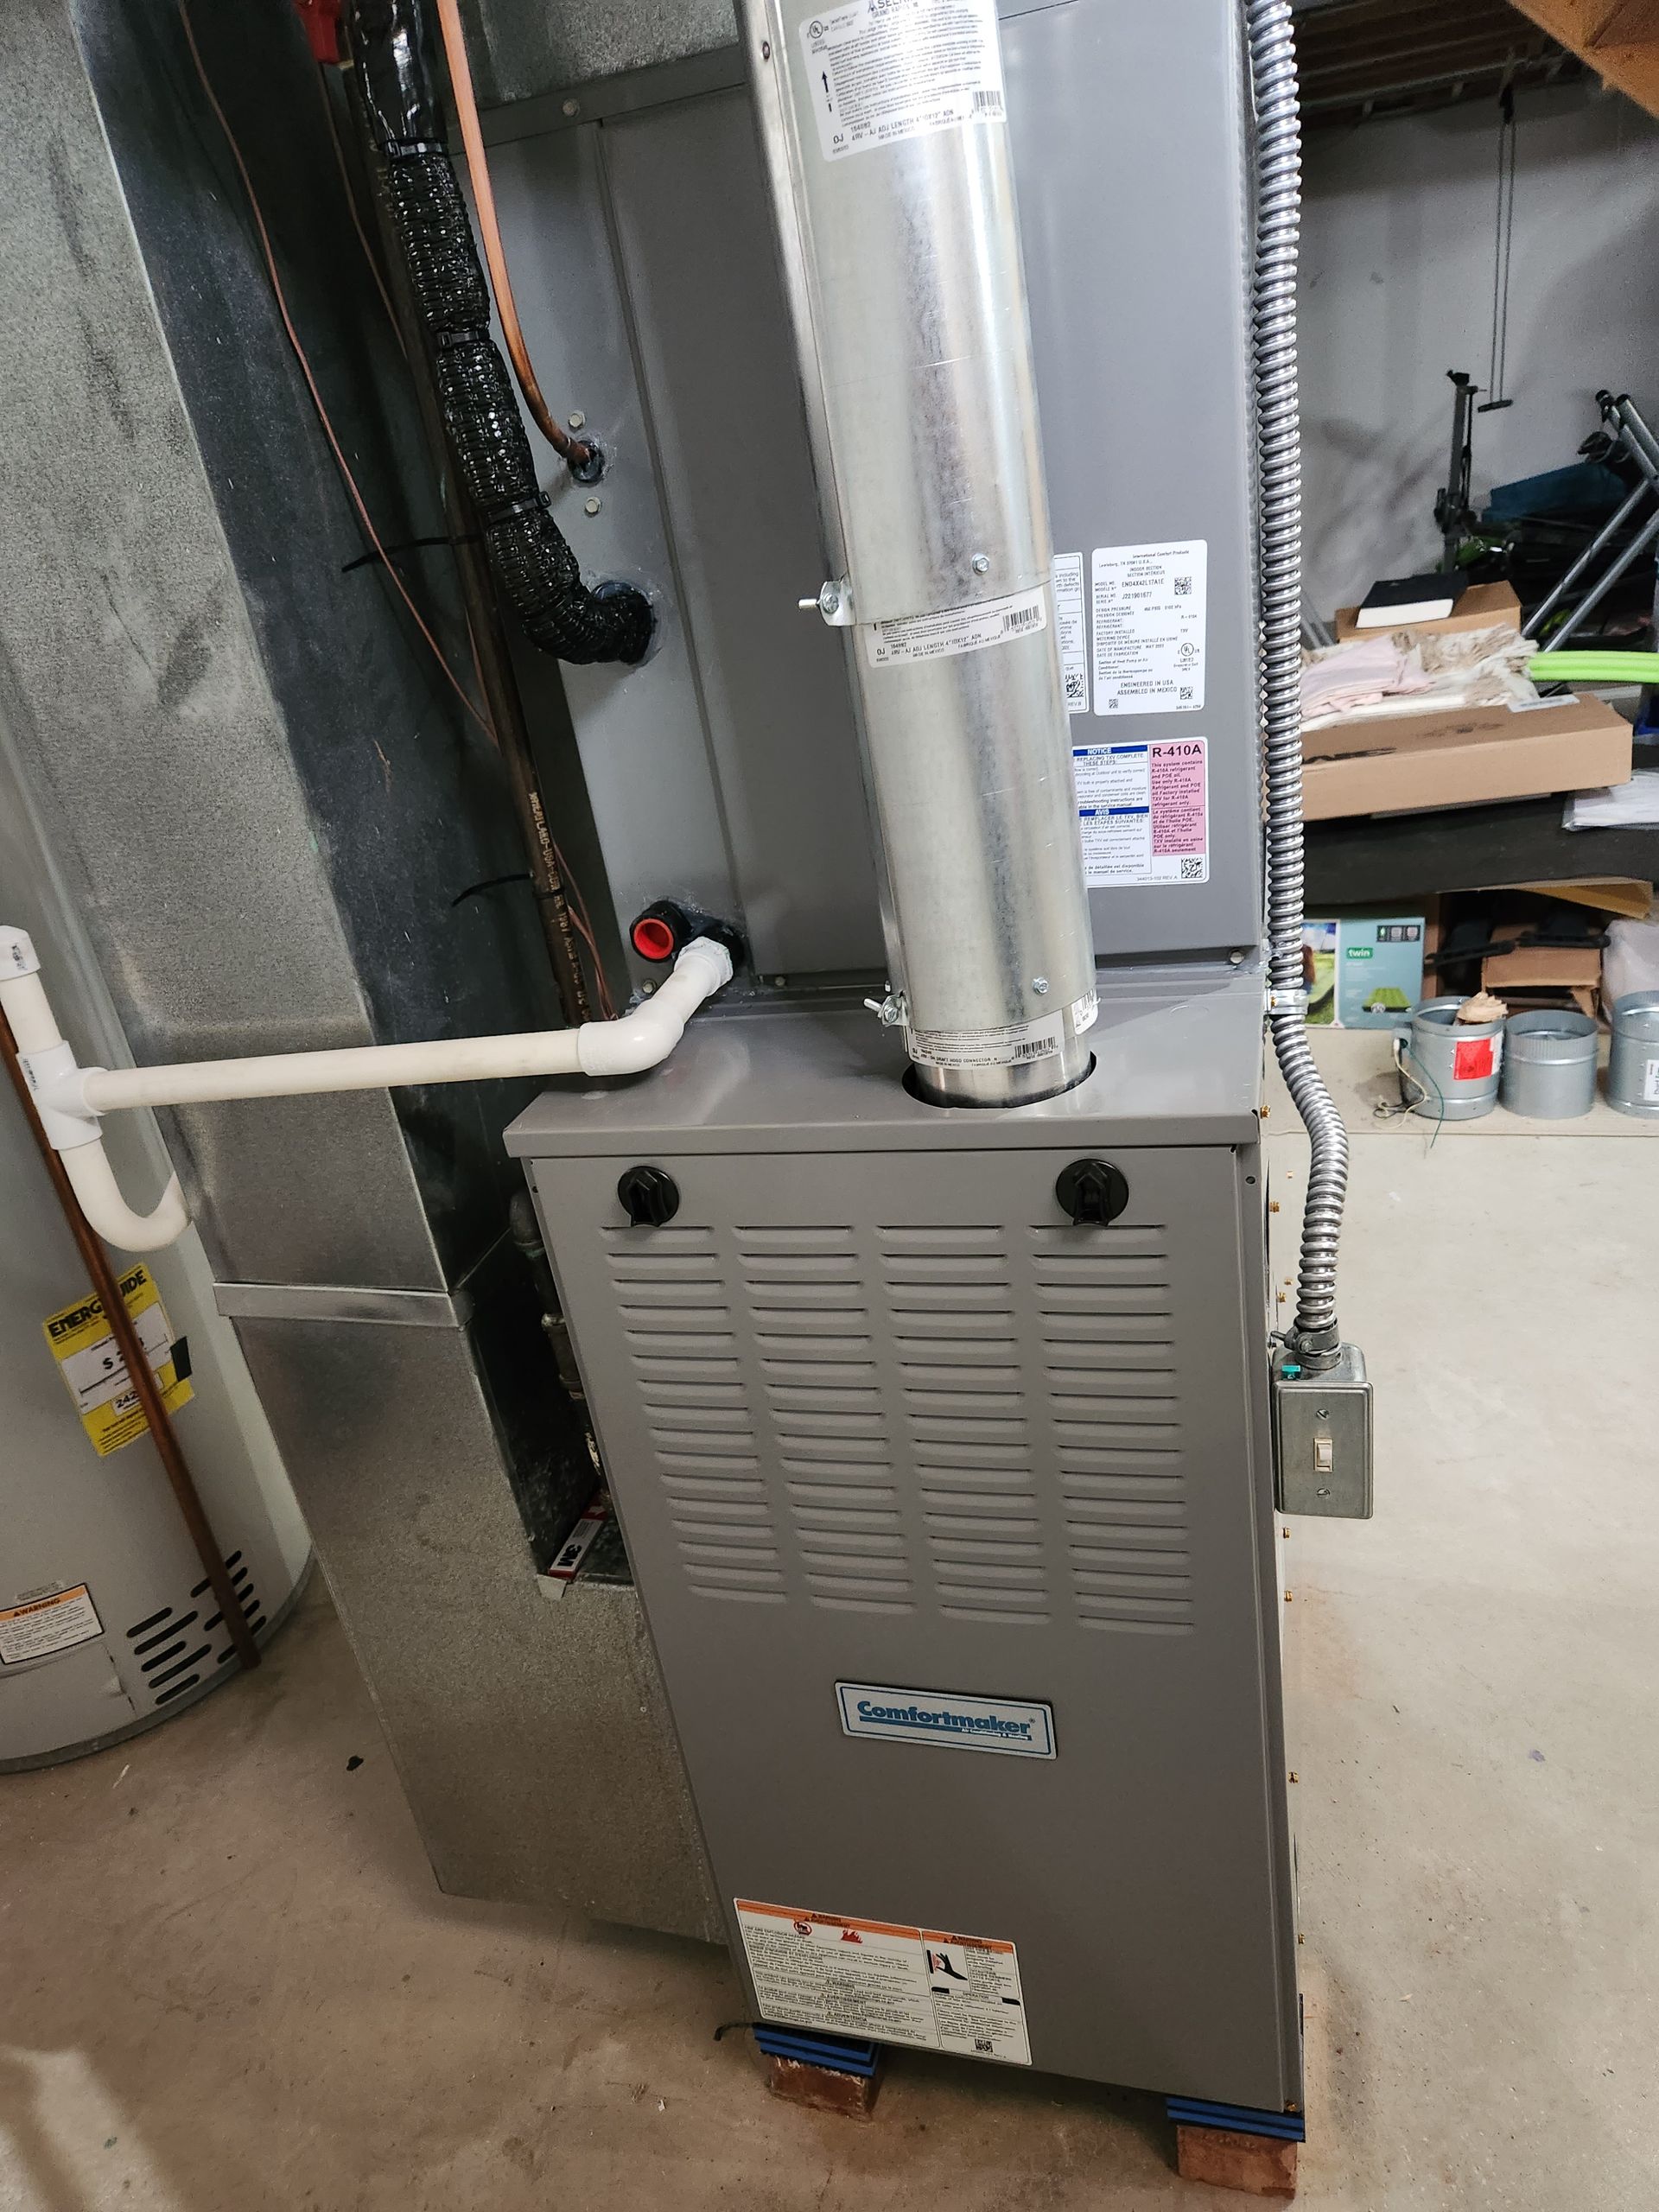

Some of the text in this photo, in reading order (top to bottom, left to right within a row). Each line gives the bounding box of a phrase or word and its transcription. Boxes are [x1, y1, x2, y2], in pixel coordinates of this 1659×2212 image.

[891, 118, 913, 129] LENGTH
[923, 641, 944, 651] LENGTH
[1153, 744, 1202, 758] R-410A
[20, 1597, 60, 1615] WARNING
[857, 1700, 1031, 1734] Comfortmaker
